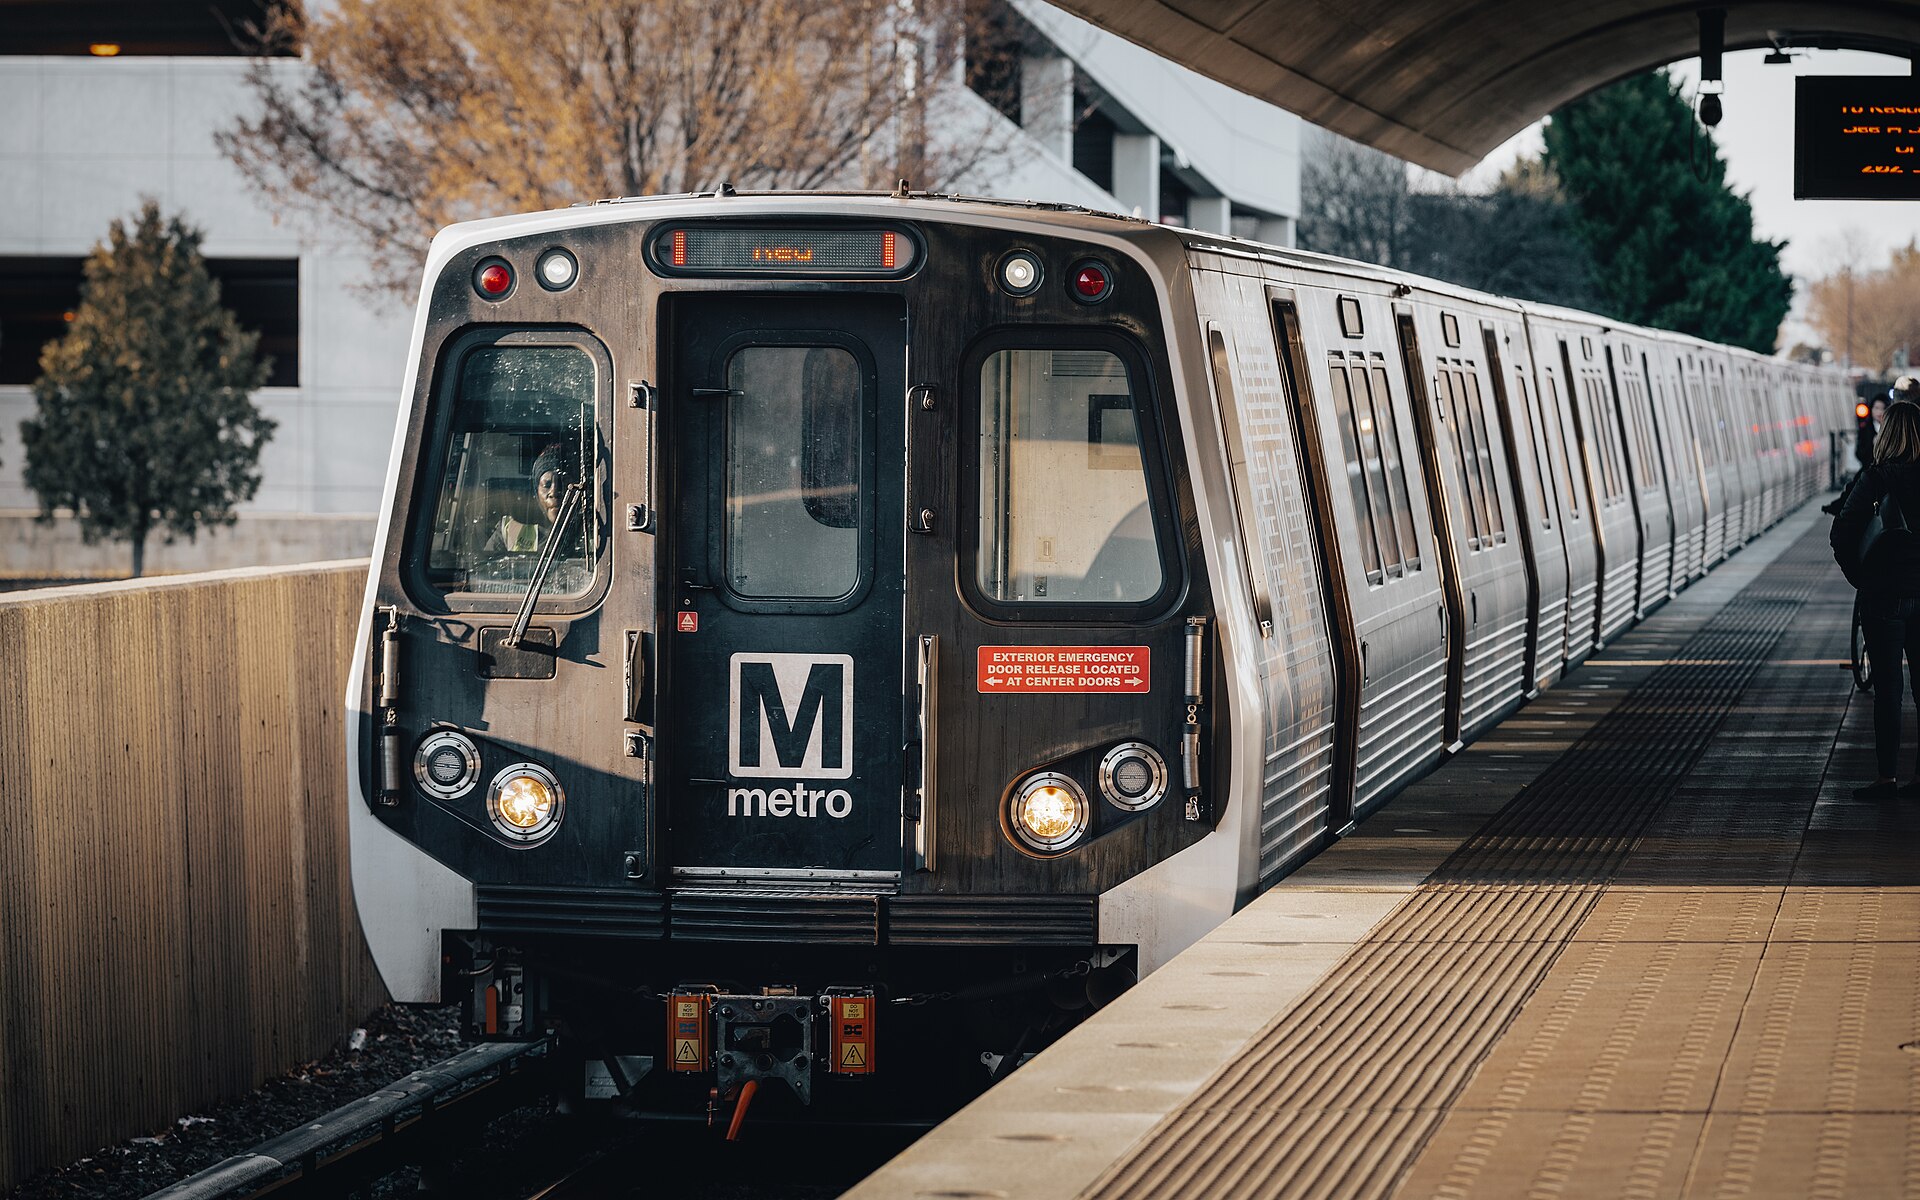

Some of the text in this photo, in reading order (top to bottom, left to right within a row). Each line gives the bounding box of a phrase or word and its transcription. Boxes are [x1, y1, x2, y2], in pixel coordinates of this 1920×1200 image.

[993, 652, 1134, 662] EXTERIOR EMERGENCY
[987, 665, 1140, 674] DOOR RELEASE LOCATED
[1006, 677, 1121, 686] AT CENTER DOORS
[739, 662, 844, 769] M
[727, 782, 853, 819] metro
